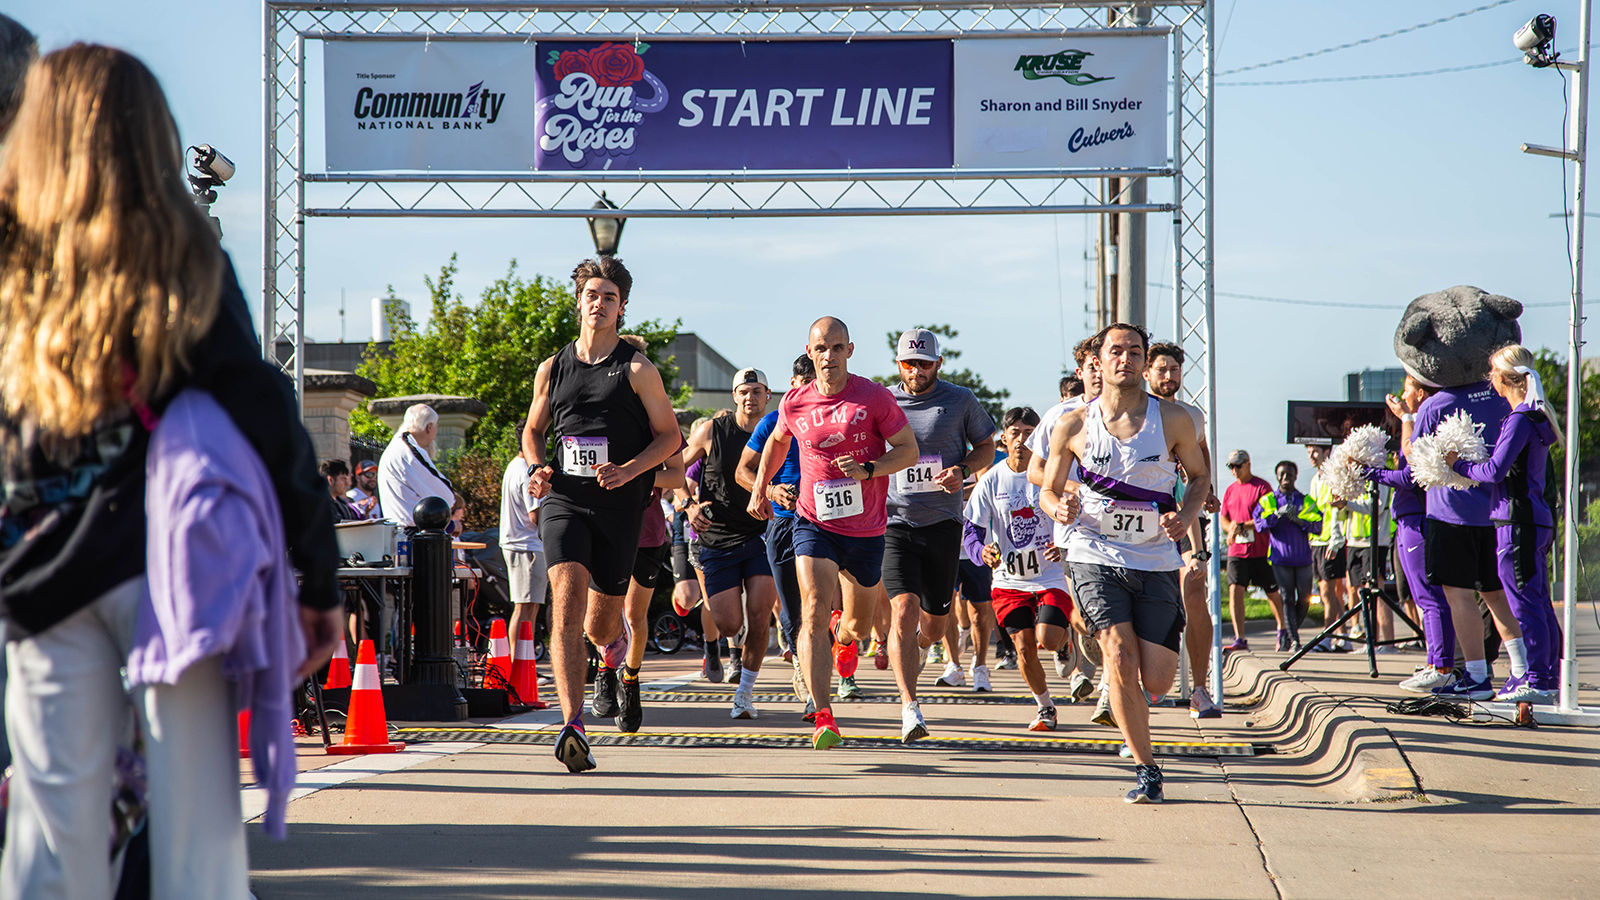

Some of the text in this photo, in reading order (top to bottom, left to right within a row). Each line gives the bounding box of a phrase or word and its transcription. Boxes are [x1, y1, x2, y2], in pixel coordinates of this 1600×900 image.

[1014, 55, 1087, 71] KRUSE
[554, 72, 633, 121] Run
[980, 98, 1142, 113] Sharon and Bill Snyder
[678, 87, 936, 127] START LINE
[358, 120, 483, 130] NATIONAL BANK
[593, 108, 643, 129] for the
[539, 113, 635, 163] Roses
[1068, 121, 1135, 153] Culver's
[908, 340, 926, 349] M
[795, 405, 868, 434] GUMP
[852, 432, 867, 443] 76
[572, 450, 597, 466] 159
[907, 467, 933, 483] 614
[825, 489, 853, 508] 516
[1113, 514, 1145, 533] 371
[1007, 550, 1039, 576] 814
